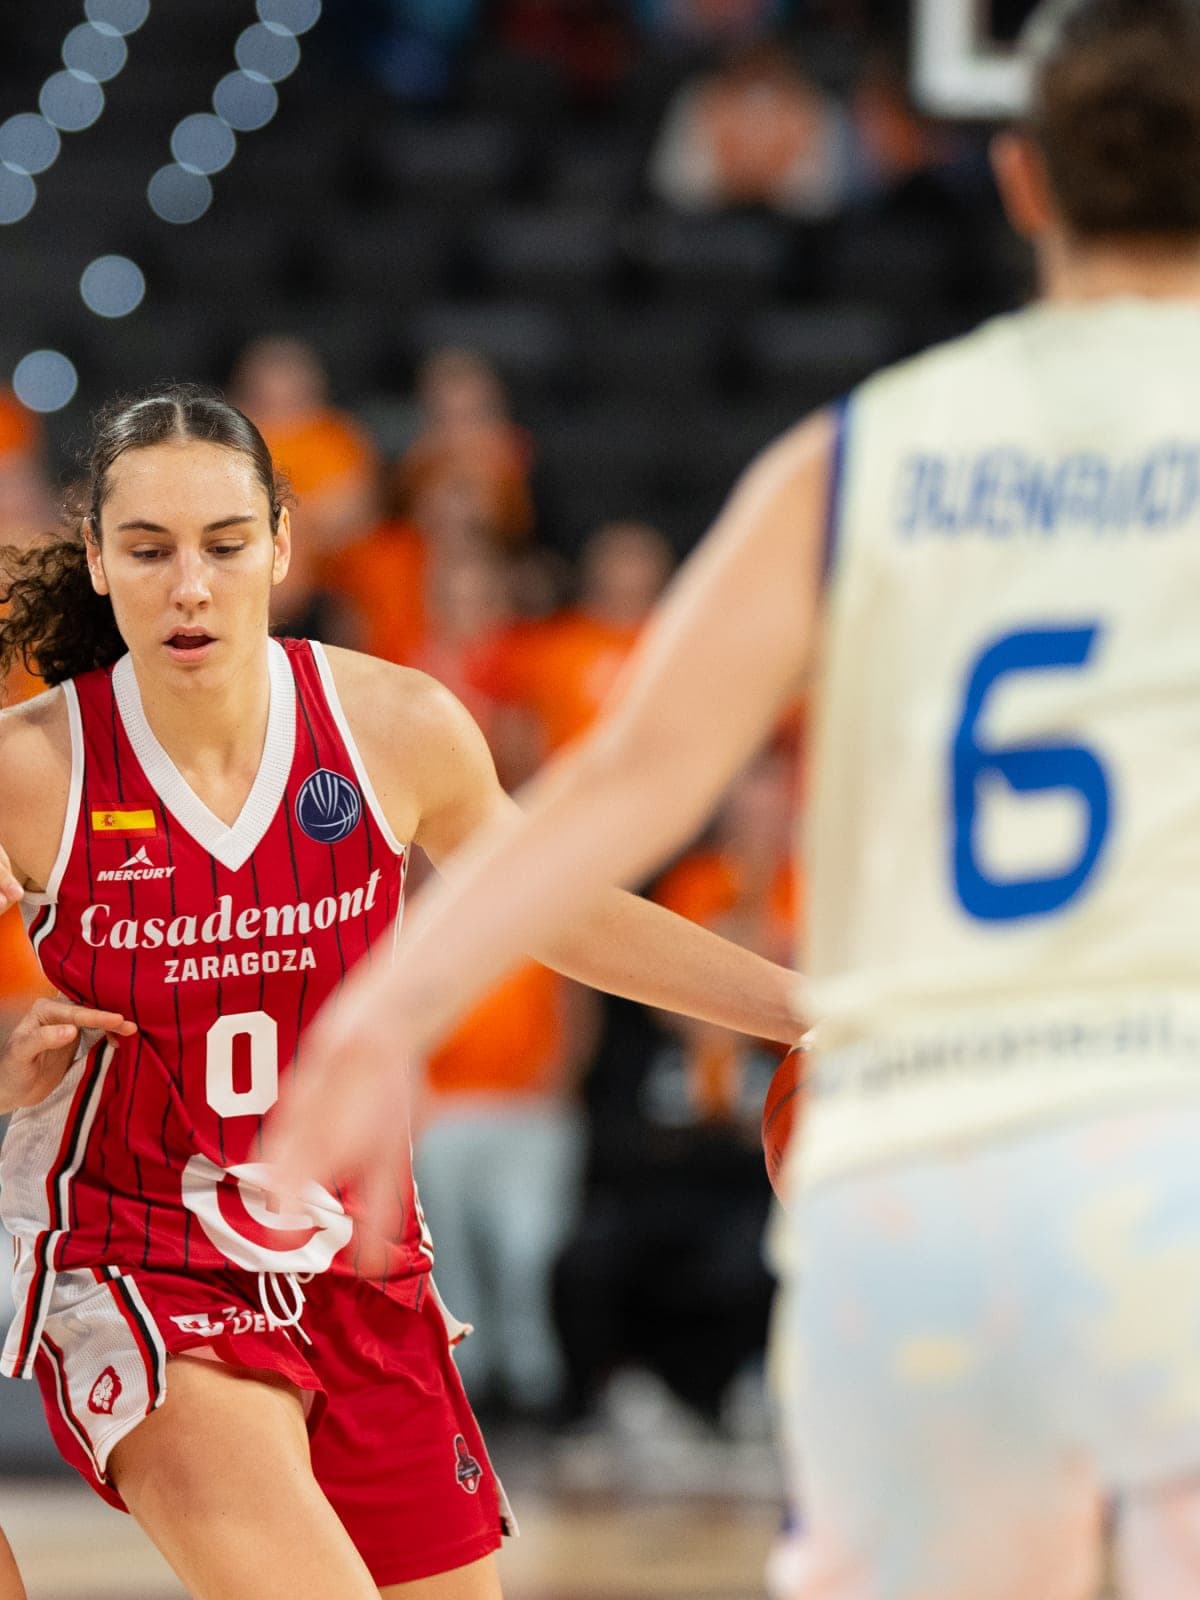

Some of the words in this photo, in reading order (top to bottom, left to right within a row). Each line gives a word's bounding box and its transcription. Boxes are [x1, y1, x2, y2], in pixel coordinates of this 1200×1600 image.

[950, 626, 1114, 924] 6
[80, 868, 382, 949] Casademont
[96, 866, 176, 881] MERCURY
[163, 947, 317, 984] ZARAGOZA
[206, 1011, 278, 1118] 0
